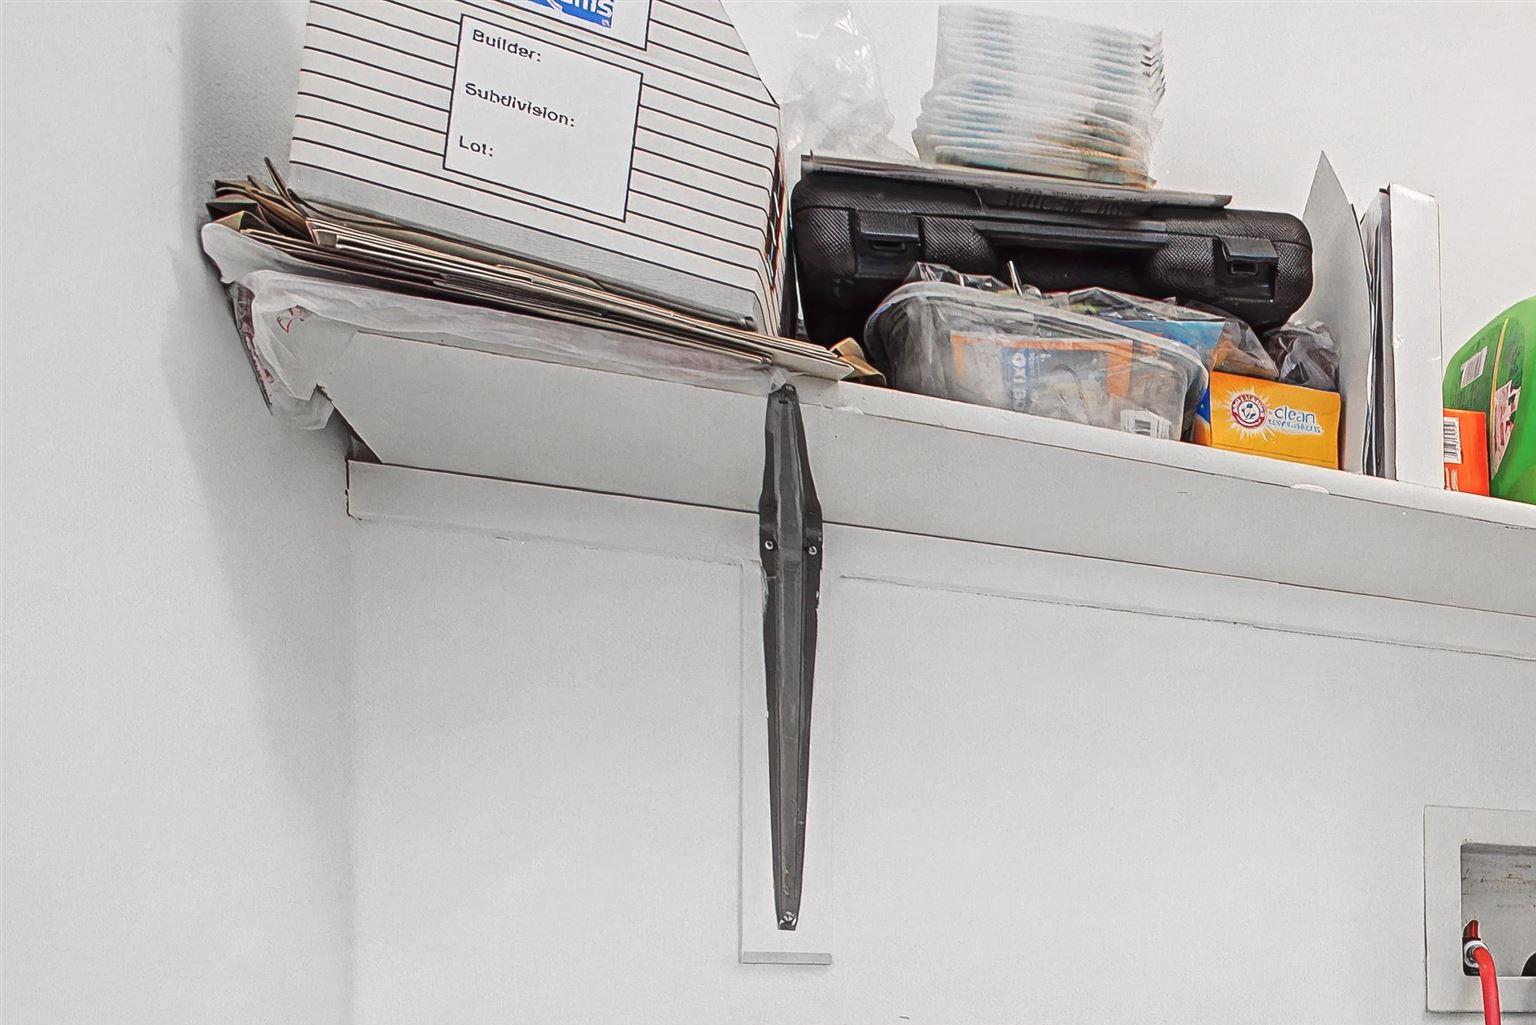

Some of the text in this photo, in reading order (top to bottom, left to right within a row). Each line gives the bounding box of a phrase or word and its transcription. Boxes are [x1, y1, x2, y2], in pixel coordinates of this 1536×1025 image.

[472, 29, 542, 62] Builder:
[464, 83, 576, 128] Subdivision:
[459, 135, 494, 158] Lot:
[1274, 406, 1315, 423] clean
